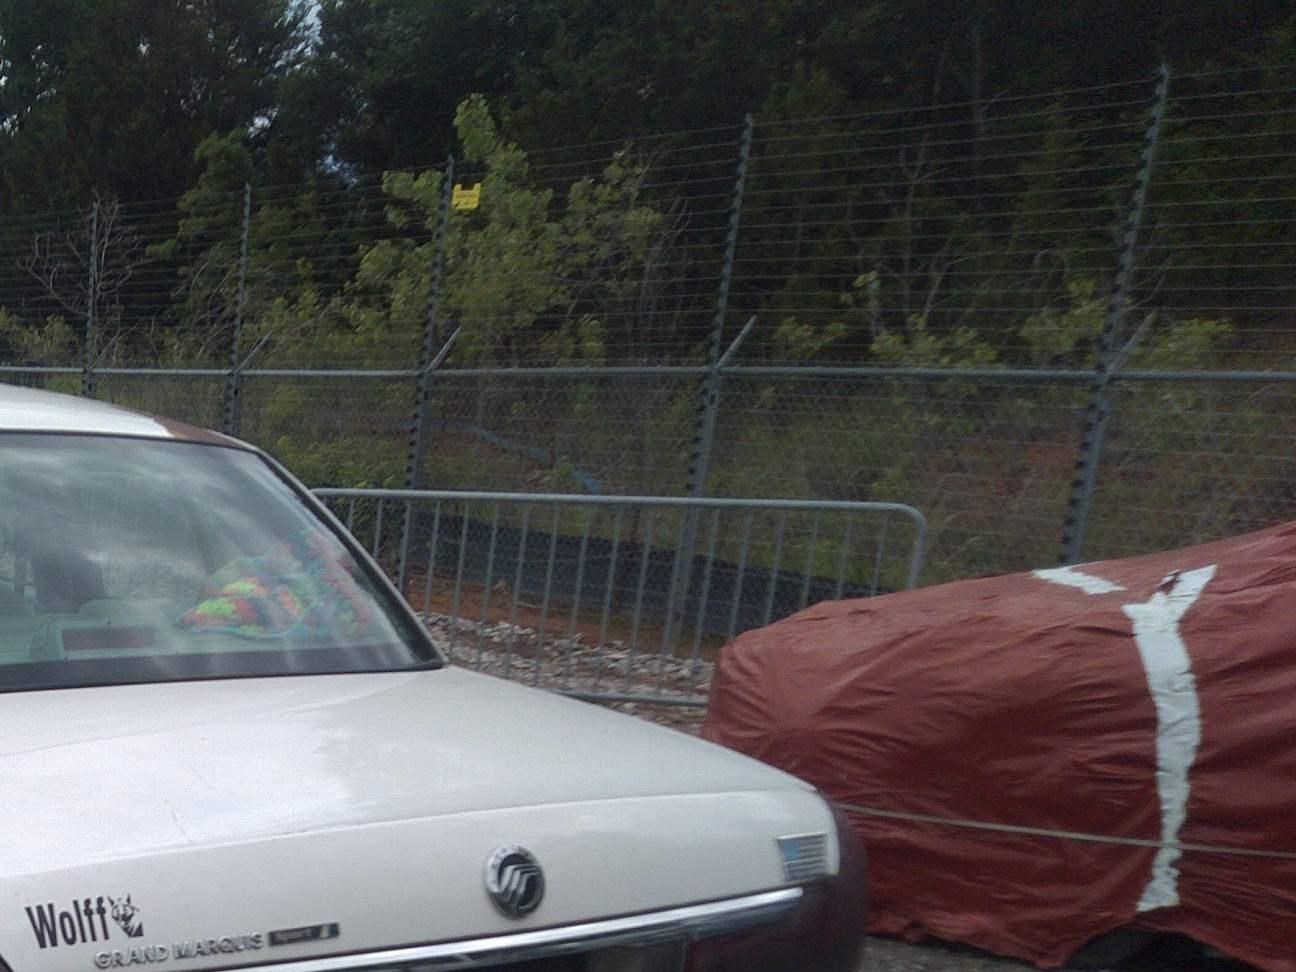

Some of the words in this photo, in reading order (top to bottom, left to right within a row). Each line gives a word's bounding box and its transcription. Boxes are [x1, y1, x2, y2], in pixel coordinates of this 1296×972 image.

[25, 896, 110, 949] Wolff
[94, 947, 168, 969] GRAND
[174, 931, 264, 960] MARQUIS
